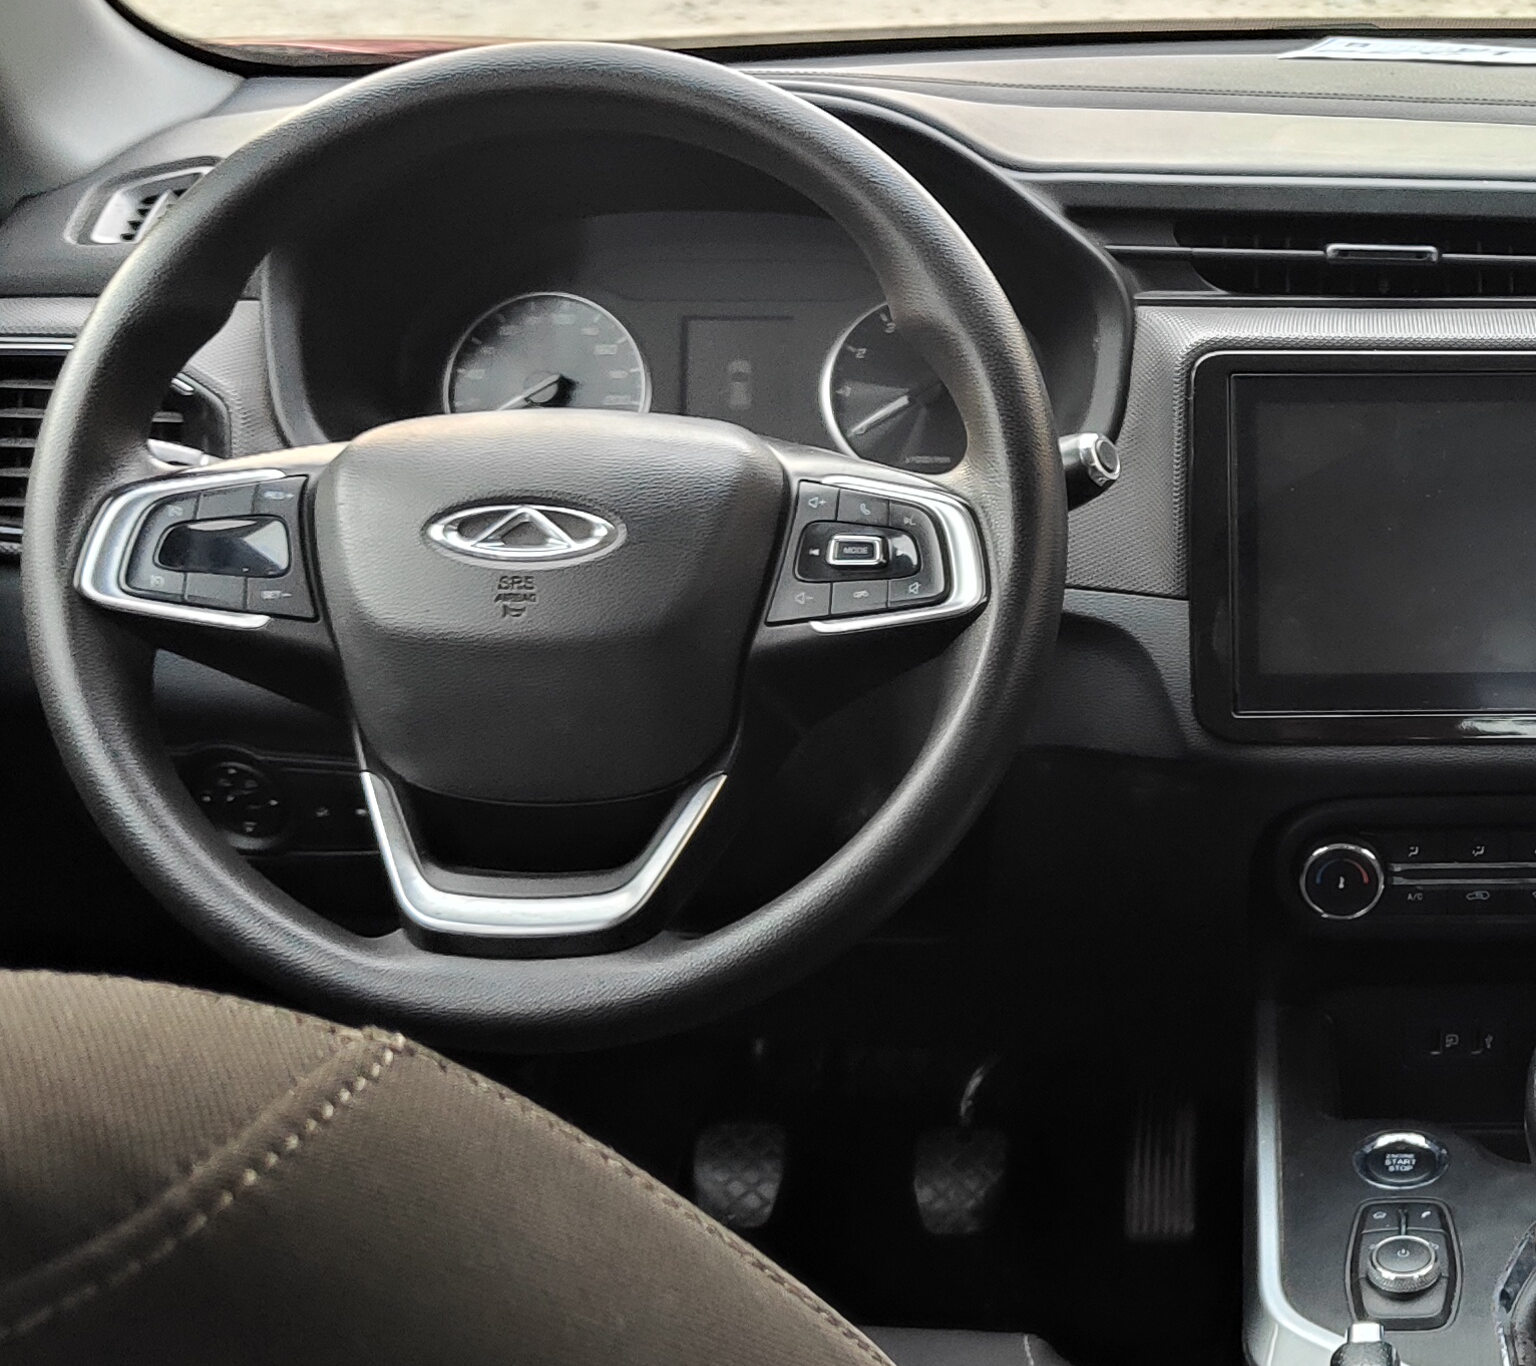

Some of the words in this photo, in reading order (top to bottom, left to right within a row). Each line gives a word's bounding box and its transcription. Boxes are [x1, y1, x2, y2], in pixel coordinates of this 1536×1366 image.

[842, 546, 869, 555] MODE
[1407, 892, 1423, 901] A/C
[1384, 1158, 1417, 1166] START
